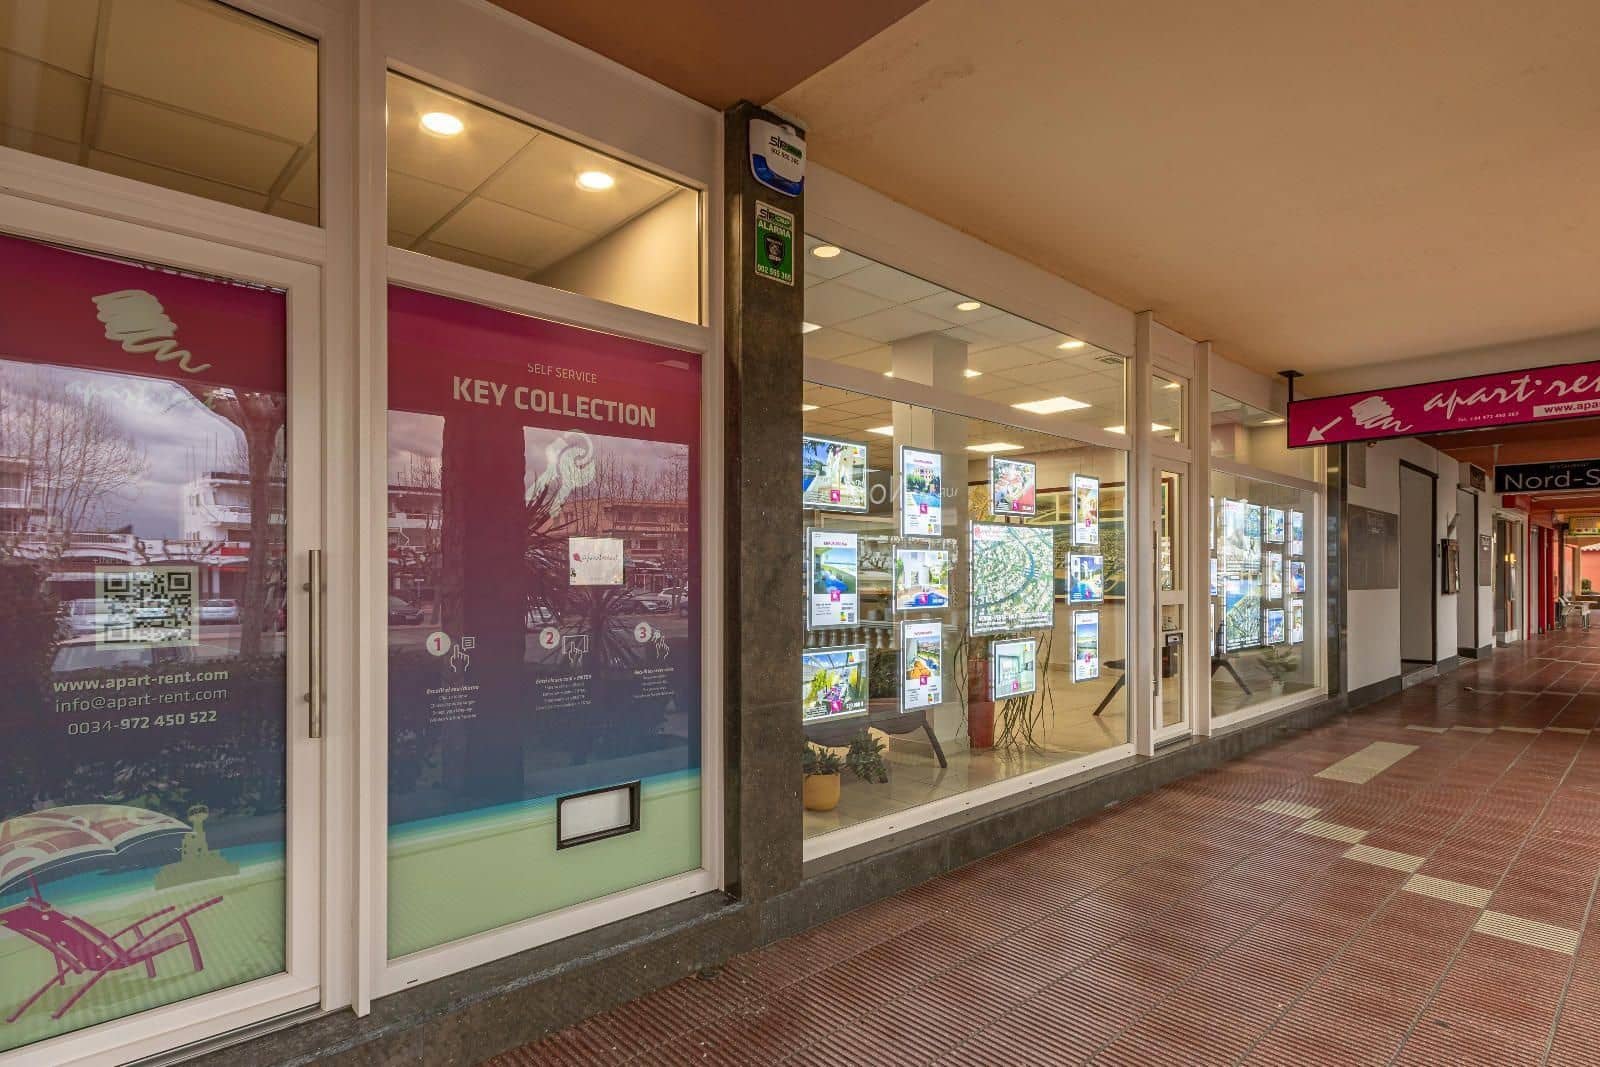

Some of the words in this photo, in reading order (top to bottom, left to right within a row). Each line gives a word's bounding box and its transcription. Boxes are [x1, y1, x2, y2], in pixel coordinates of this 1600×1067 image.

[758, 220, 791, 239] ALARMA
[527, 362, 553, 376] SELF
[555, 367, 598, 384] SERVICE
[452, 375, 509, 407] KEY
[514, 386, 656, 428] COLLECTION
[53, 670, 229, 692] www.apart-rent.com
[55, 689, 227, 713] info@apart-rent.com
[68, 717, 150, 735] 0034-972
[154, 713, 185, 727] 450
[190, 710, 217, 724] 522
